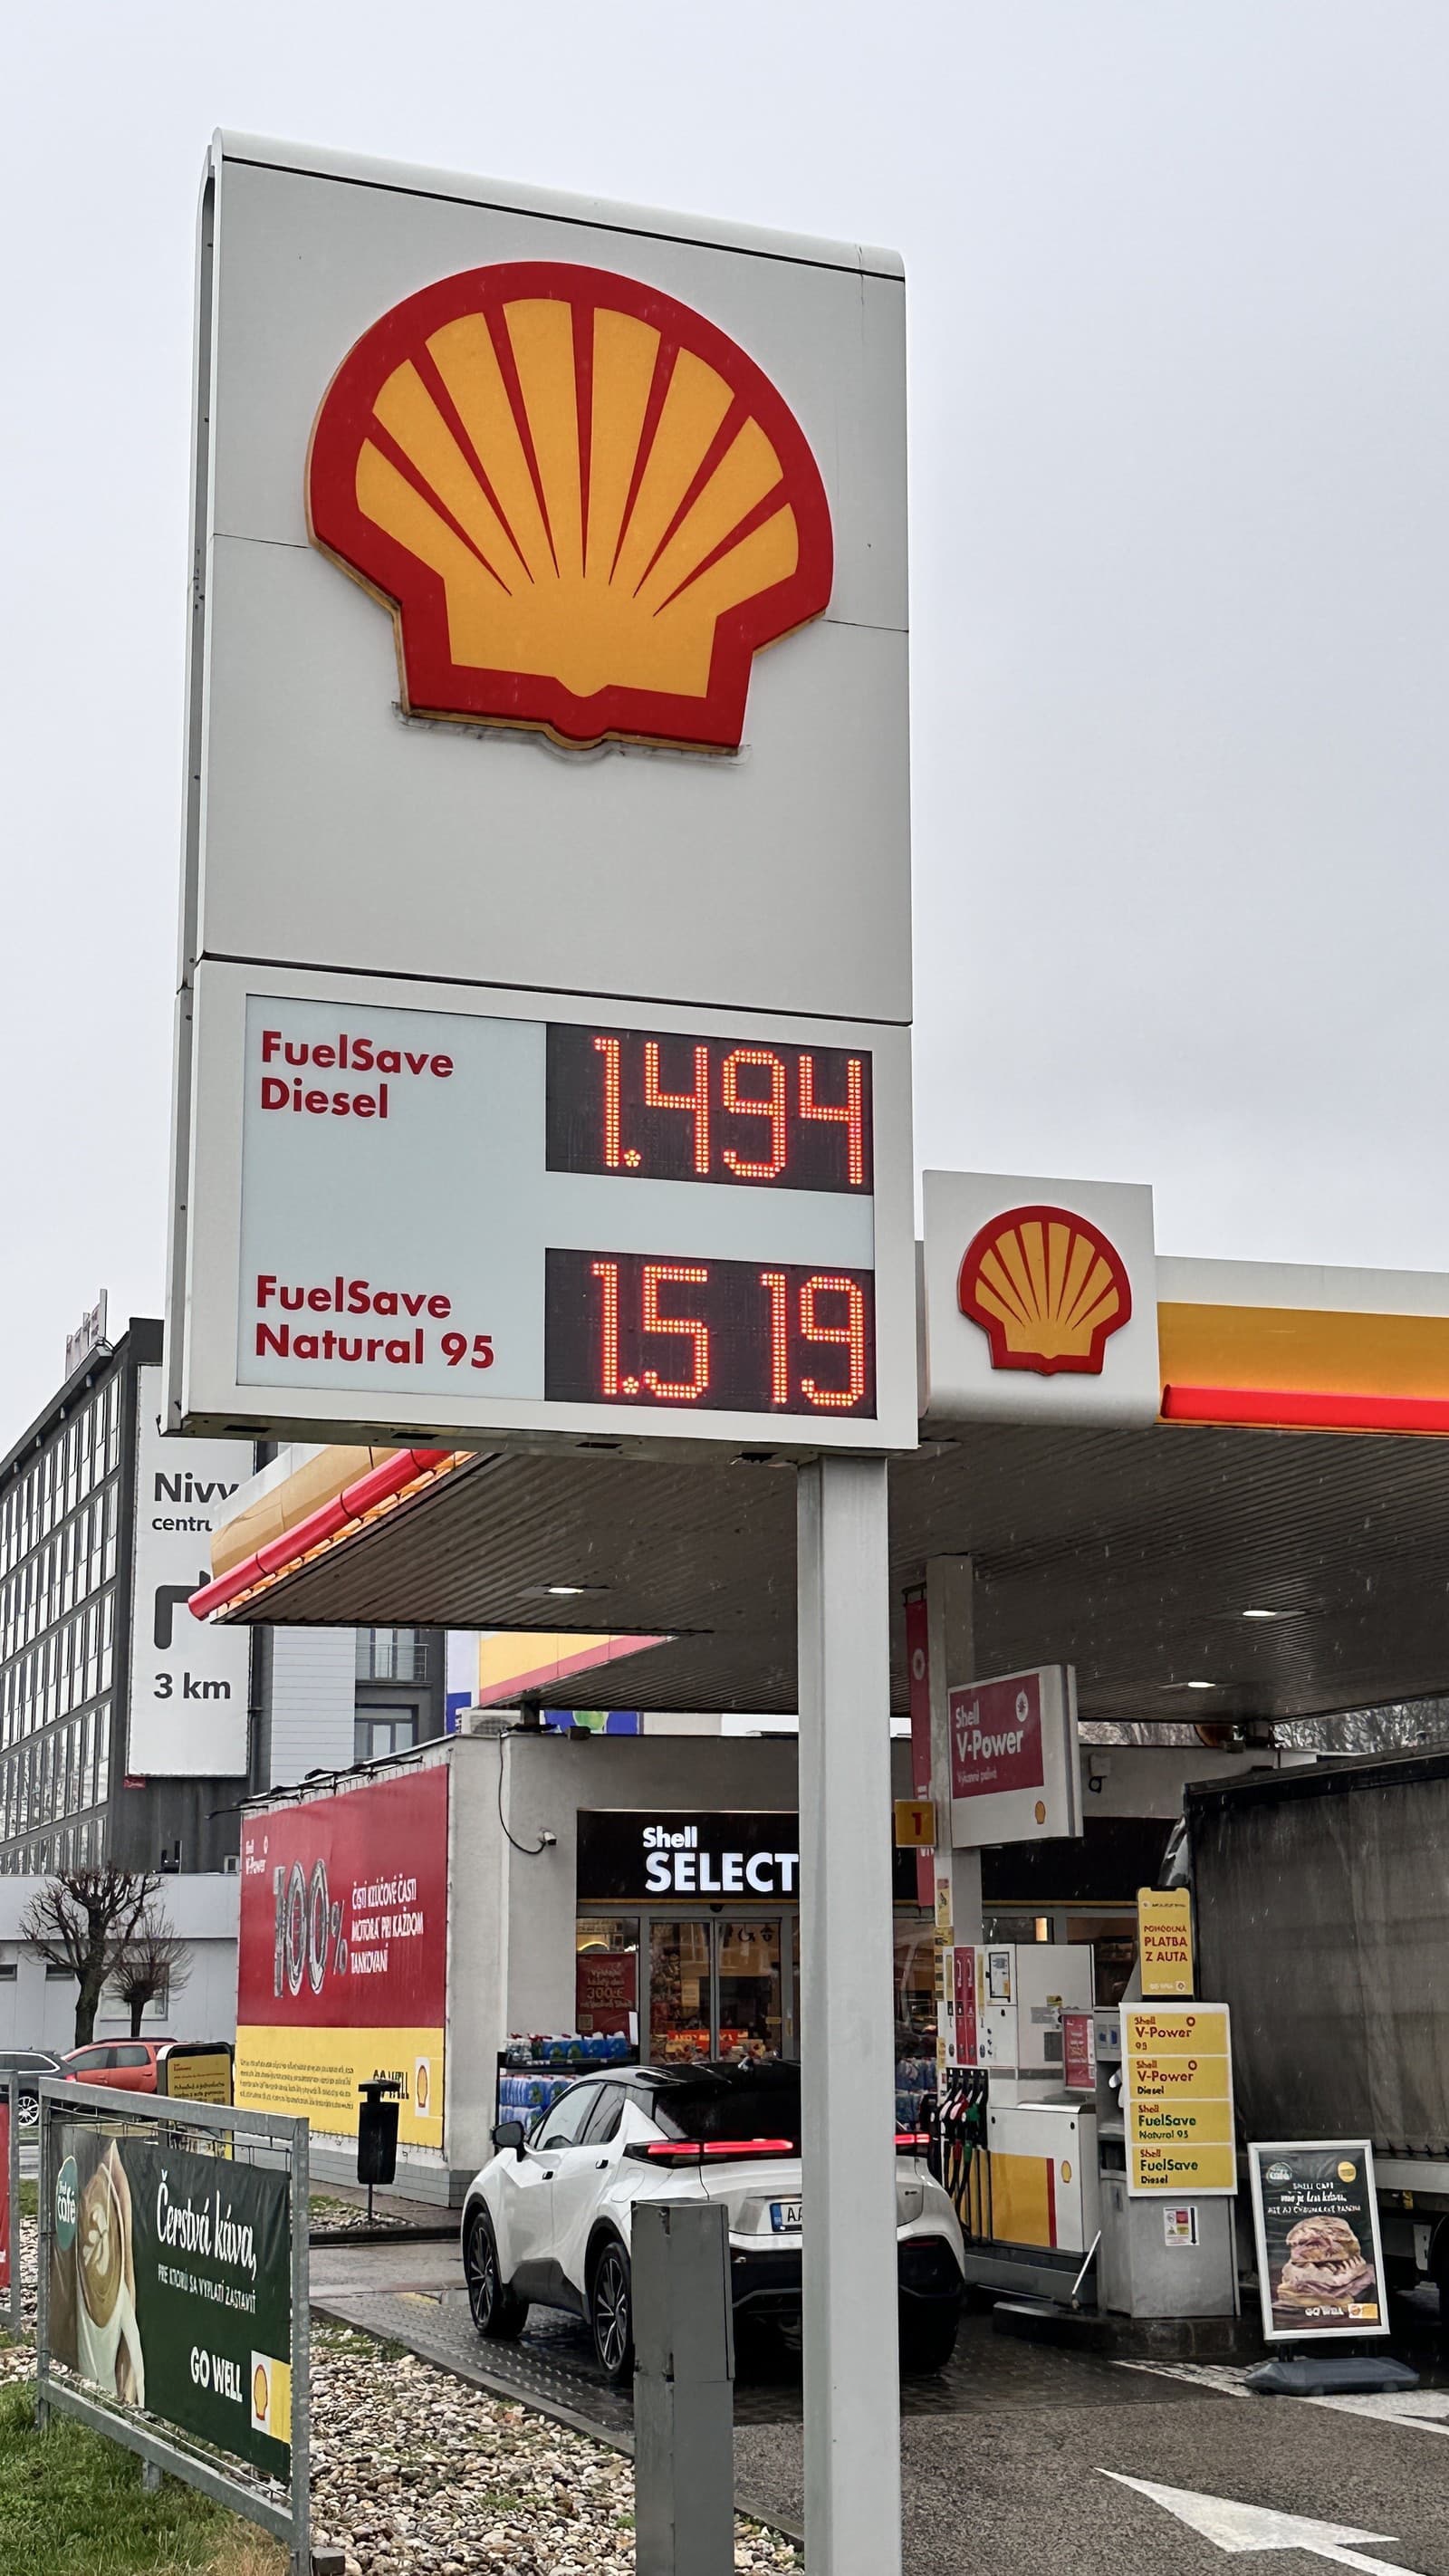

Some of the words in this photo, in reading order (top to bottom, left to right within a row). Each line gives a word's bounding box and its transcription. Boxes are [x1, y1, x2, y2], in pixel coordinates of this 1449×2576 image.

[262, 1030, 454, 1078] FuelSave
[261, 1077, 388, 1119] Diesel
[593, 1036, 862, 1185] 1.494
[256, 1274, 452, 1318] FuelSave
[255, 1323, 424, 1364] Natural
[440, 1331, 494, 1370] 95
[592, 1262, 865, 1407] 1.519
[153, 1672, 173, 1699] 3
[183, 1672, 231, 1699] km
[955, 1699, 980, 1729] Shell
[956, 1729, 1024, 1763] V-Power
[911, 1812, 923, 1836] 1
[642, 1825, 698, 1849] Shell
[645, 1851, 799, 1892] SELECT
[1144, 1937, 1188, 1947] PLATBA
[1145, 1951, 1154, 1963] Z
[1156, 1951, 1188, 1963] AUTA
[1134, 2015, 1156, 2025] Shell
[1135, 2026, 1193, 2039] V-Power
[1136, 2060, 1158, 2070] Shell
[1137, 2070, 1195, 2082] V-Power
[1137, 2085, 1166, 2096] Diesel
[1137, 2104, 1160, 2114] Shell
[1137, 2113, 1196, 2128] FuelSave
[1138, 2129, 1175, 2139] Natural
[1139, 2148, 1162, 2158] Shell
[1139, 2158, 1199, 2172] FuelSave
[1140, 2174, 1169, 2185] Diesel
[57, 2186, 77, 2225] café
[156, 2168, 212, 2257] Čerstvá
[214, 2189, 257, 2282] káva,
[189, 2274, 198, 2295] SA
[198, 2279, 226, 2303] VYPLATÍ
[190, 2346, 210, 2389] GO
[211, 2354, 244, 2403] WELL
